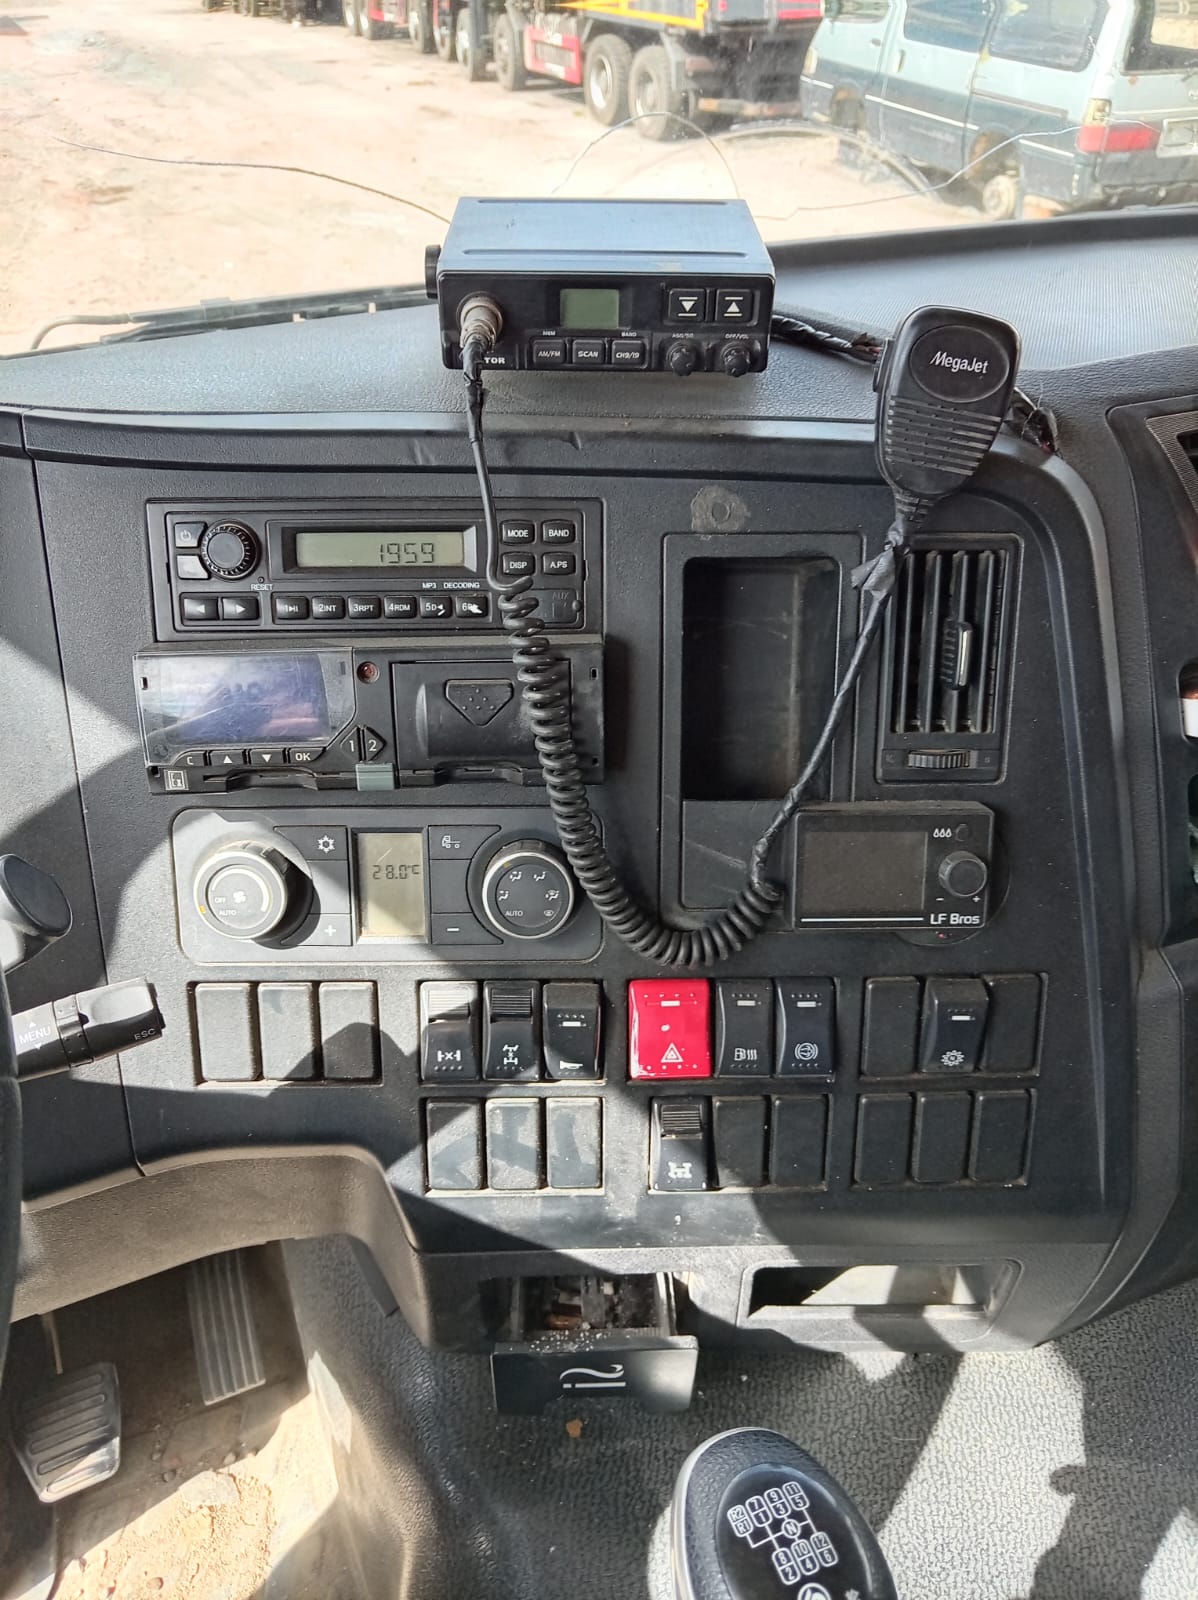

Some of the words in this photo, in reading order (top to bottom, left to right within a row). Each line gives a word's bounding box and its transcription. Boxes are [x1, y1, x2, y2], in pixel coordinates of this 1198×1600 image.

[538, 350, 561, 358] AM/FM
[577, 350, 599, 358] SCAN
[929, 350, 989, 374] MegaJet
[507, 529, 529, 538] MODE
[548, 529, 570, 537] BAND
[509, 561, 528, 569] DISP
[250, 583, 273, 591] RESET
[422, 582, 437, 590] MP3
[353, 603, 374, 612] 3RPT
[388, 603, 411, 612] 4RDM
[349, 740, 355, 752] 1
[368, 740, 377, 752] 2
[186, 757, 193, 766] C
[295, 752, 311, 761] OK
[930, 913, 947, 925] LF
[950, 913, 980, 924] Bros
[18, 1026, 51, 1044] MENU
[134, 1028, 156, 1041] ESC
[730, 1508, 744, 1521] R2
[751, 1499, 759, 1508] 7
[769, 1491, 779, 1502] 9
[786, 1484, 799, 1495] 11
[737, 1523, 750, 1534] R1
[758, 1512, 767, 1522] 1
[776, 1504, 785, 1515] 3
[795, 1497, 804, 1507] 5
[785, 1523, 797, 1534] N
[778, 1552, 787, 1564] 8
[794, 1543, 809, 1557] 10
[813, 1536, 828, 1548] 12
[785, 1567, 795, 1580] 2
[804, 1558, 814, 1570] 4
[823, 1551, 833, 1562] 6
